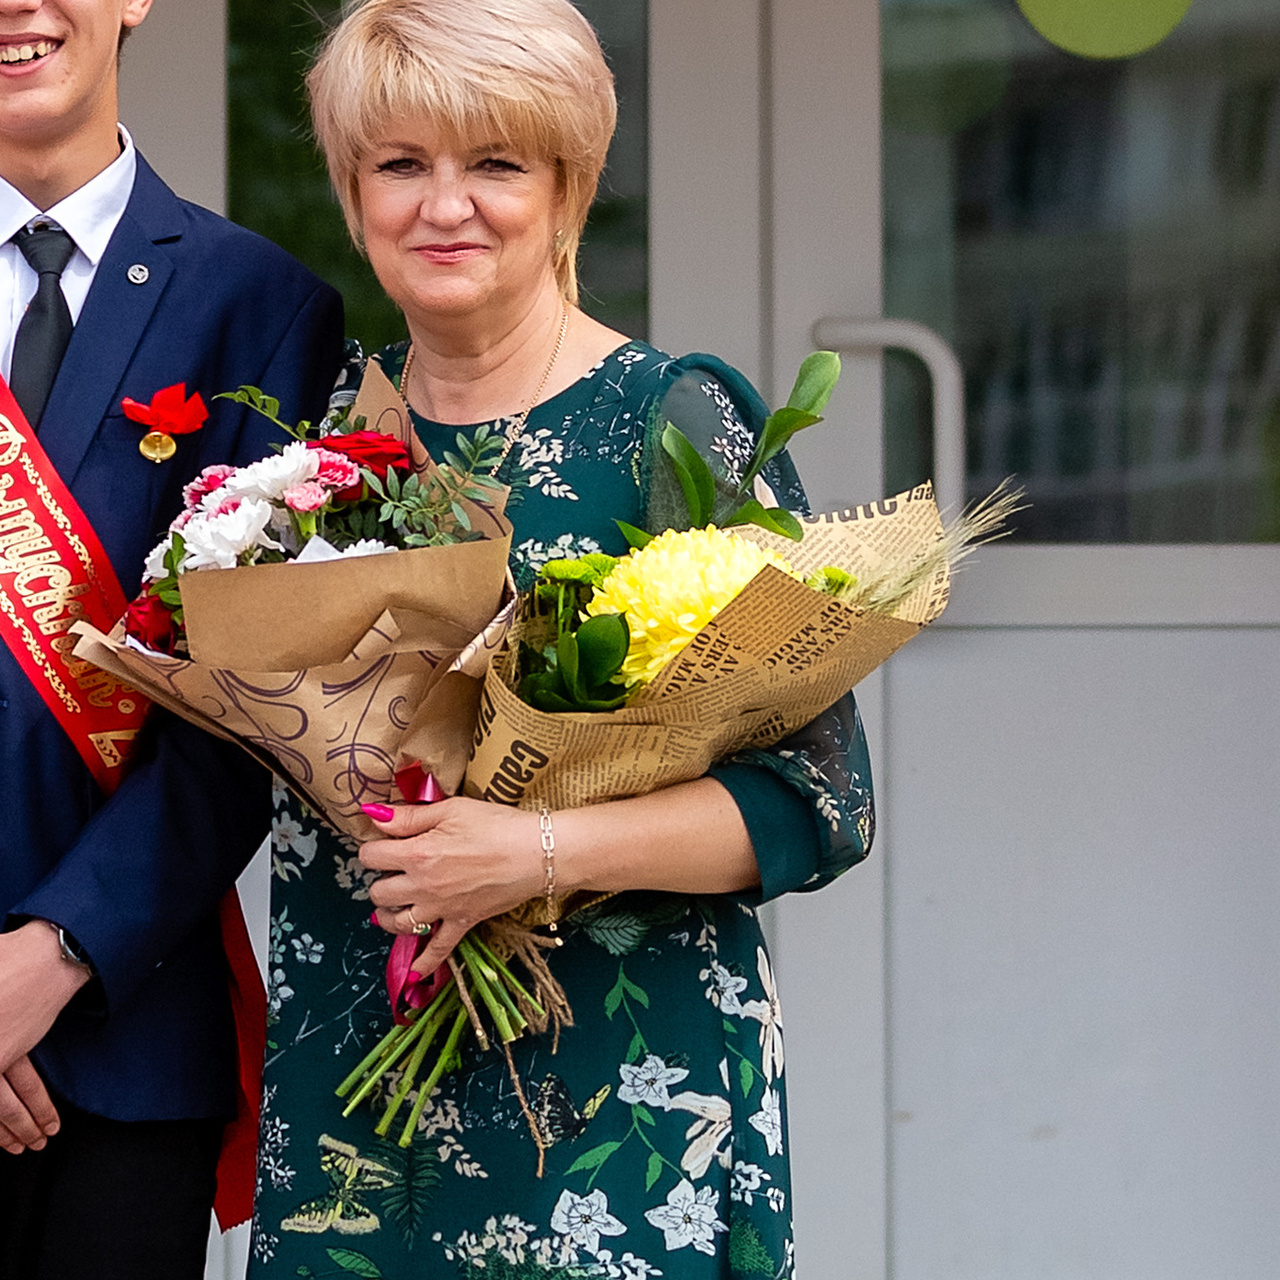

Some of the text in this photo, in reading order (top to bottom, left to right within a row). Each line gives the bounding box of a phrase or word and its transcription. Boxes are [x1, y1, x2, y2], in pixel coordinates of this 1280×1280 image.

[660, 632, 712, 698] OF MAG
[762, 600, 842, 671] OF MAGIC
[785, 636, 819, 670] AND
